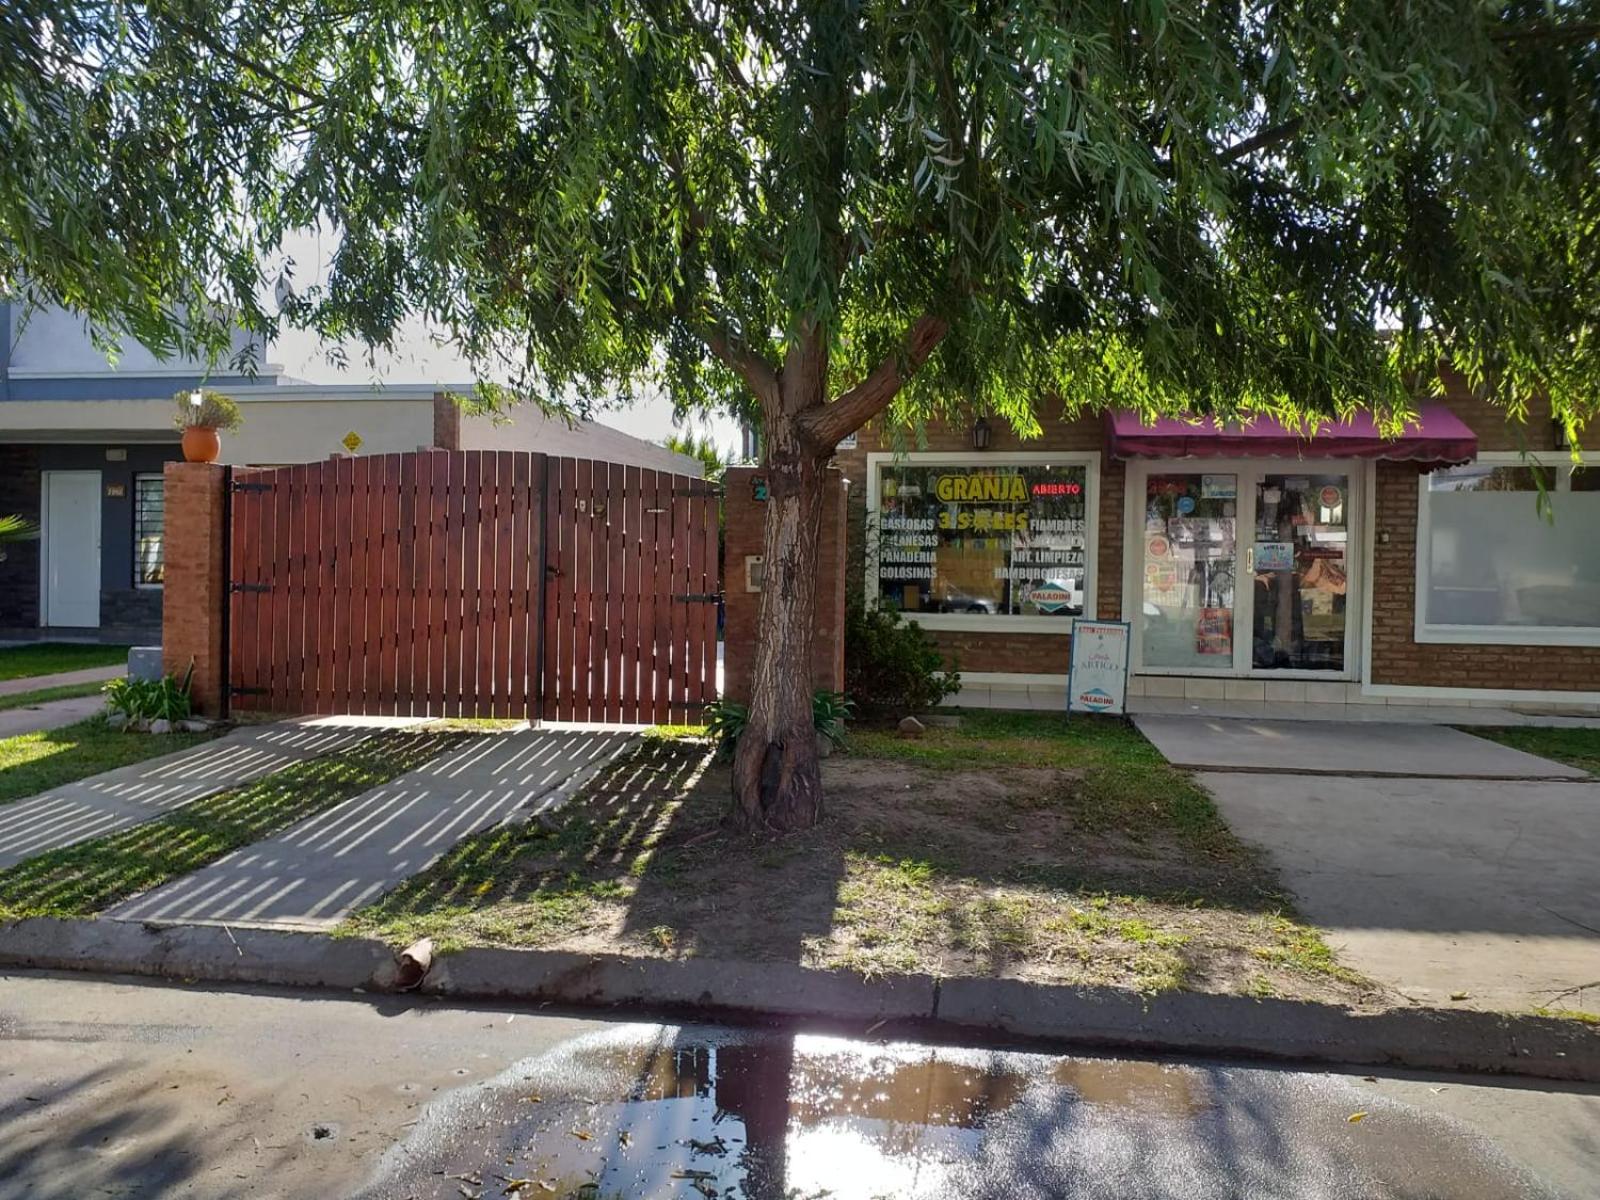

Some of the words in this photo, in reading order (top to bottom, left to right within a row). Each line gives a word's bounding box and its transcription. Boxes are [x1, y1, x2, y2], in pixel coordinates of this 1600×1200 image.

[936, 475, 1028, 502] GRANJA
[1032, 482, 1081, 496] ABIERTO
[881, 518, 935, 530] GASEOSAS
[938, 511, 951, 529] 3
[1030, 519, 1084, 531] FIAMBRES
[880, 534, 939, 546] LANESAS
[880, 551, 937, 563] PANADERIA
[1035, 551, 1084, 563] LIMPIEZA
[880, 566, 937, 579] GOLOSINAS
[994, 567, 1084, 580] HAMBURGUESAS
[1031, 591, 1071, 601] PALADINI
[1079, 695, 1114, 705] PALADINI
